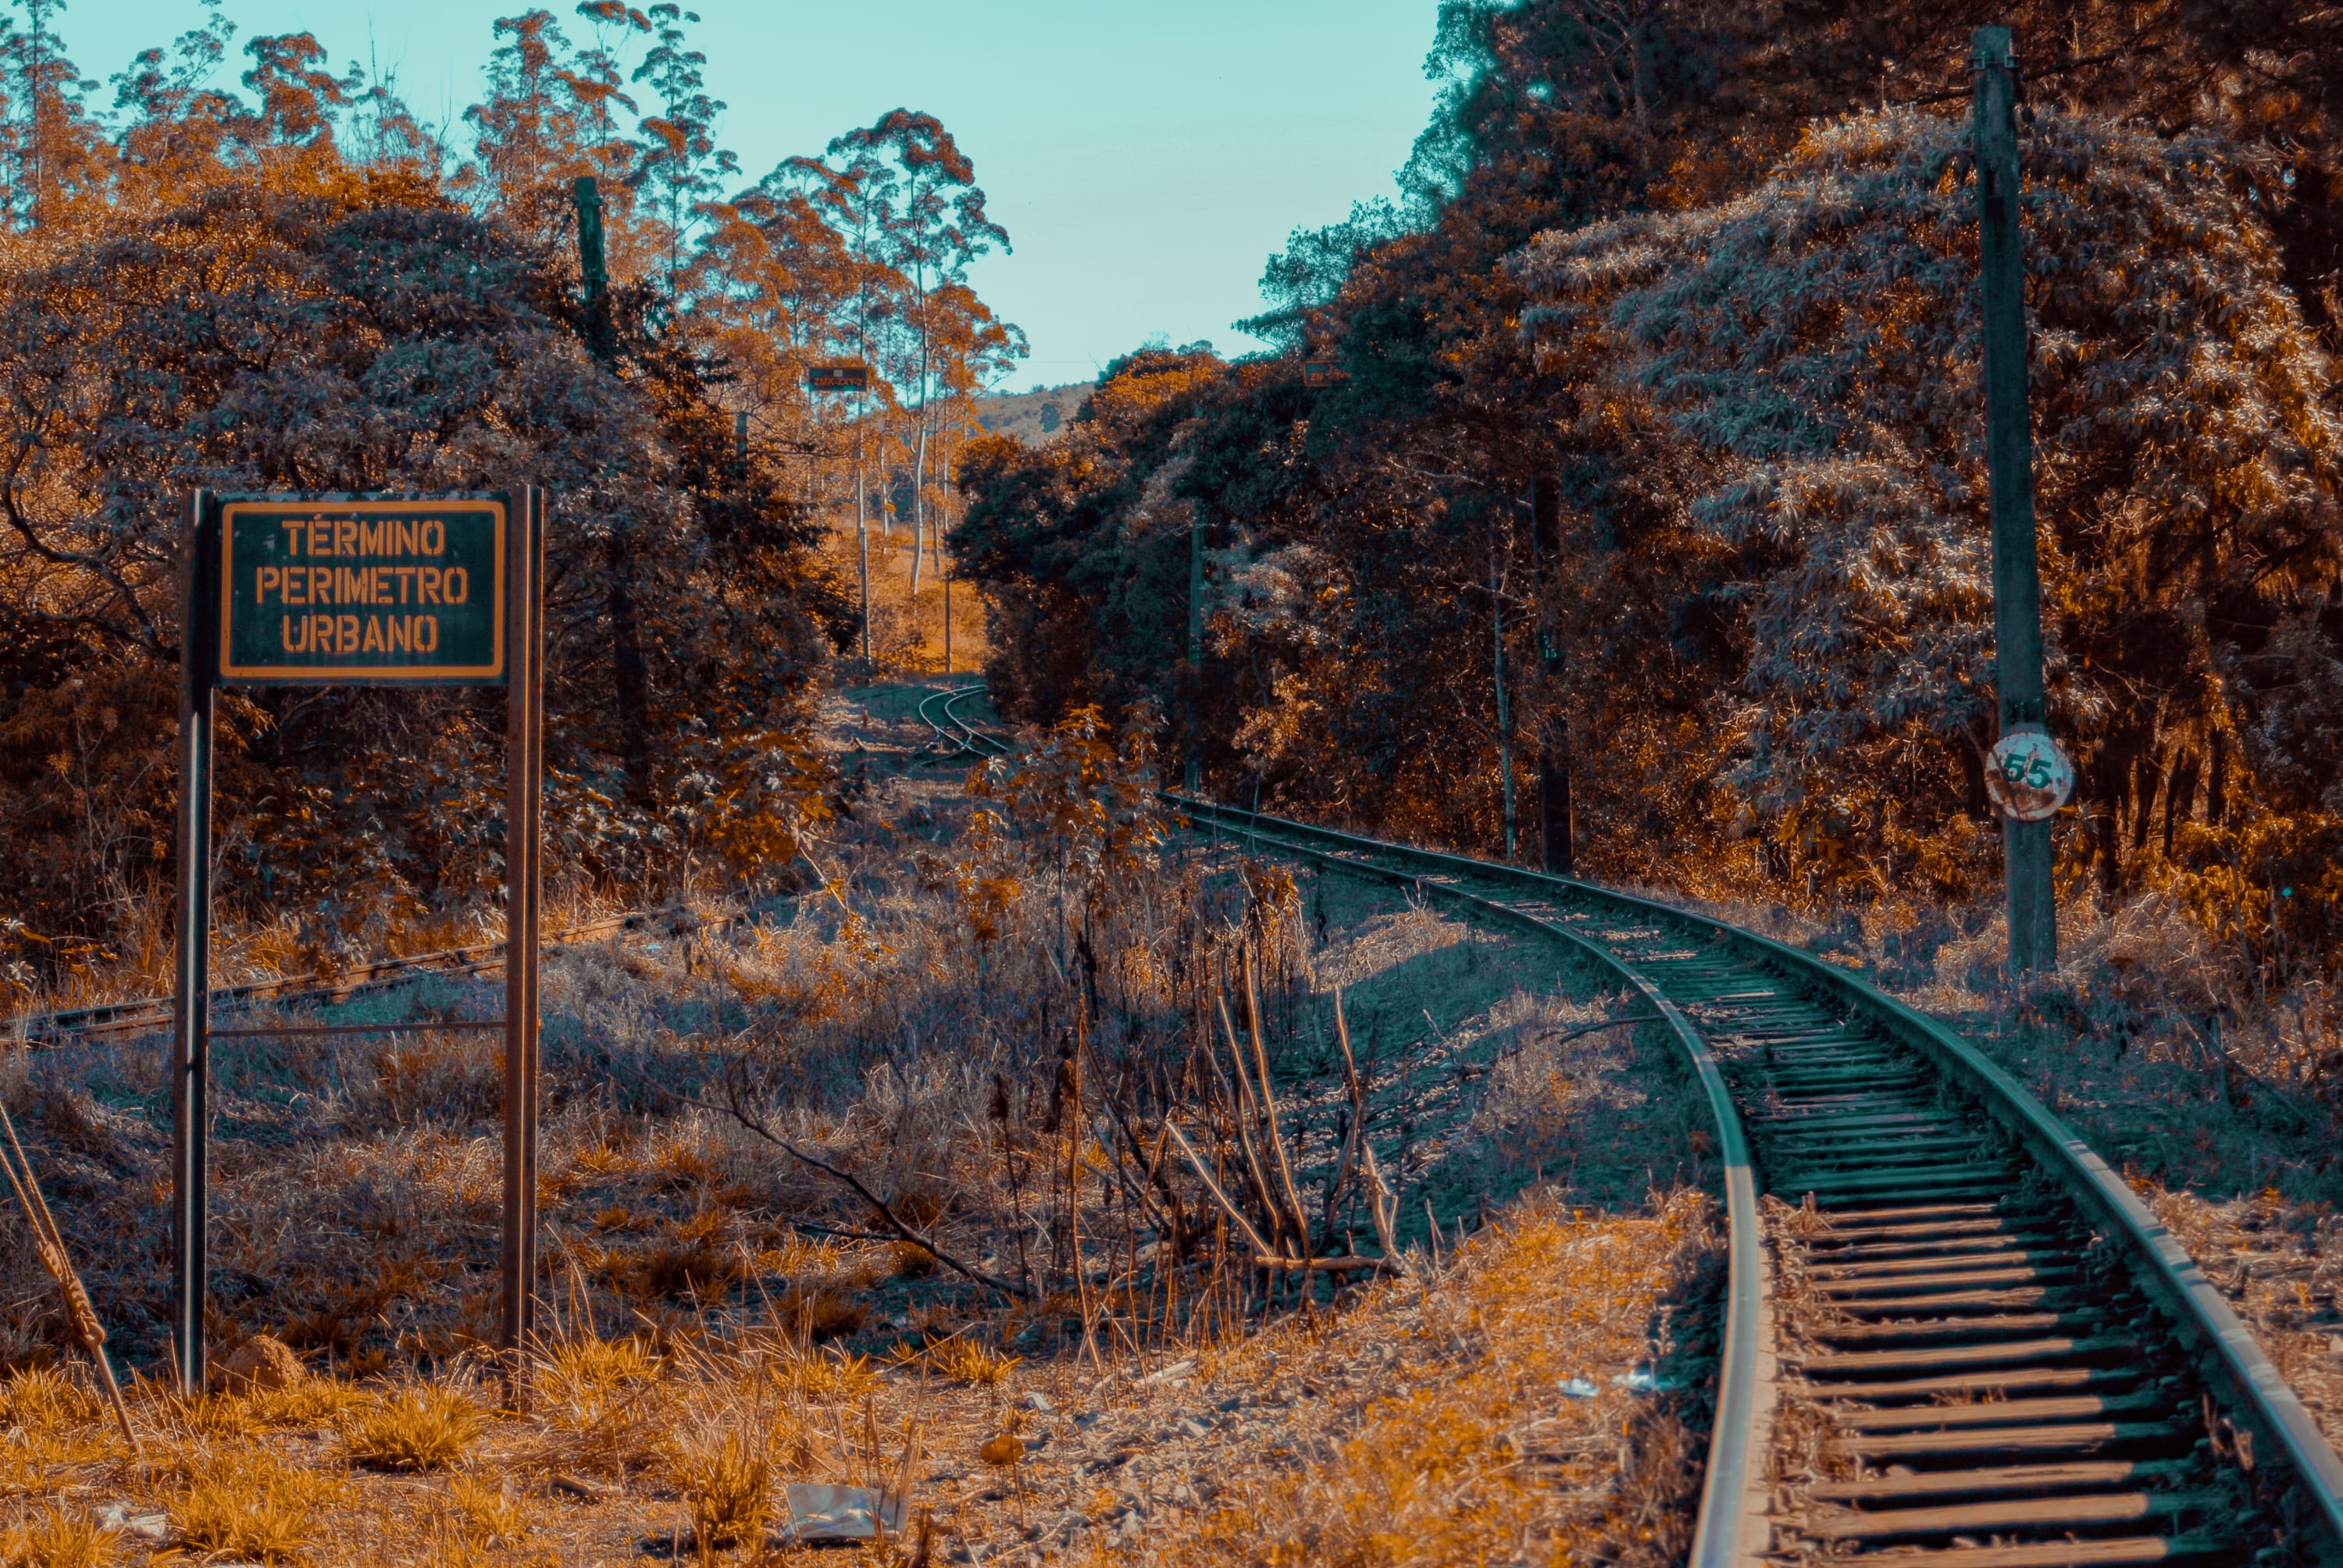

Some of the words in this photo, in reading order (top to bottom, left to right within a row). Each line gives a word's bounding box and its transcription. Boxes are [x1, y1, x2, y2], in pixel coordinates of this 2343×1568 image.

[282, 512, 446, 556] TÉRMINO
[256, 567, 468, 604] PERIMETRO
[282, 615, 439, 653] URBANO
[2002, 753, 2052, 789] 55
